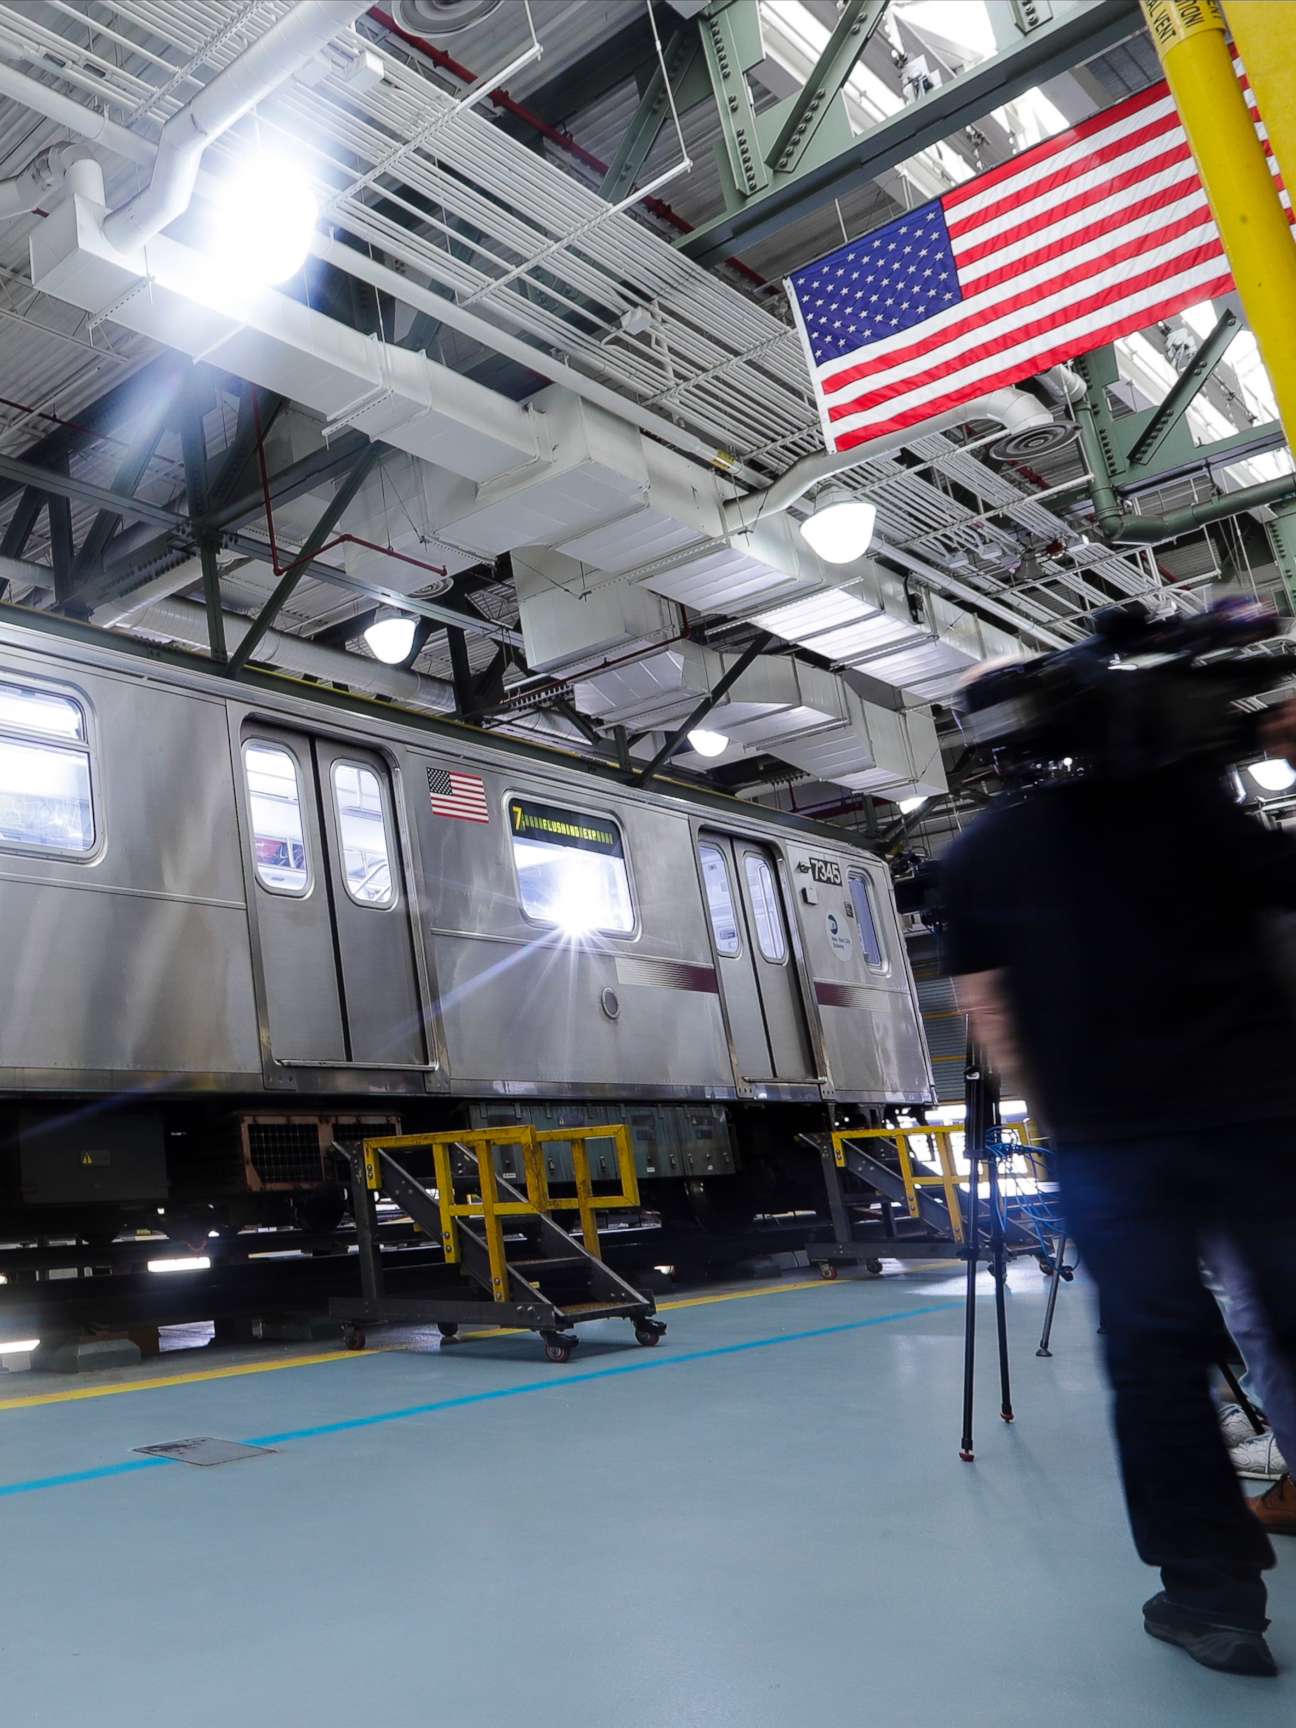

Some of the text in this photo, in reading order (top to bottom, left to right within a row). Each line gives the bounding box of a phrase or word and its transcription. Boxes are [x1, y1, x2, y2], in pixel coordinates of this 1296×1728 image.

[1153, 9, 1177, 44] VENT
[512, 805, 523, 831] 7
[810, 859, 841, 884] 7345
